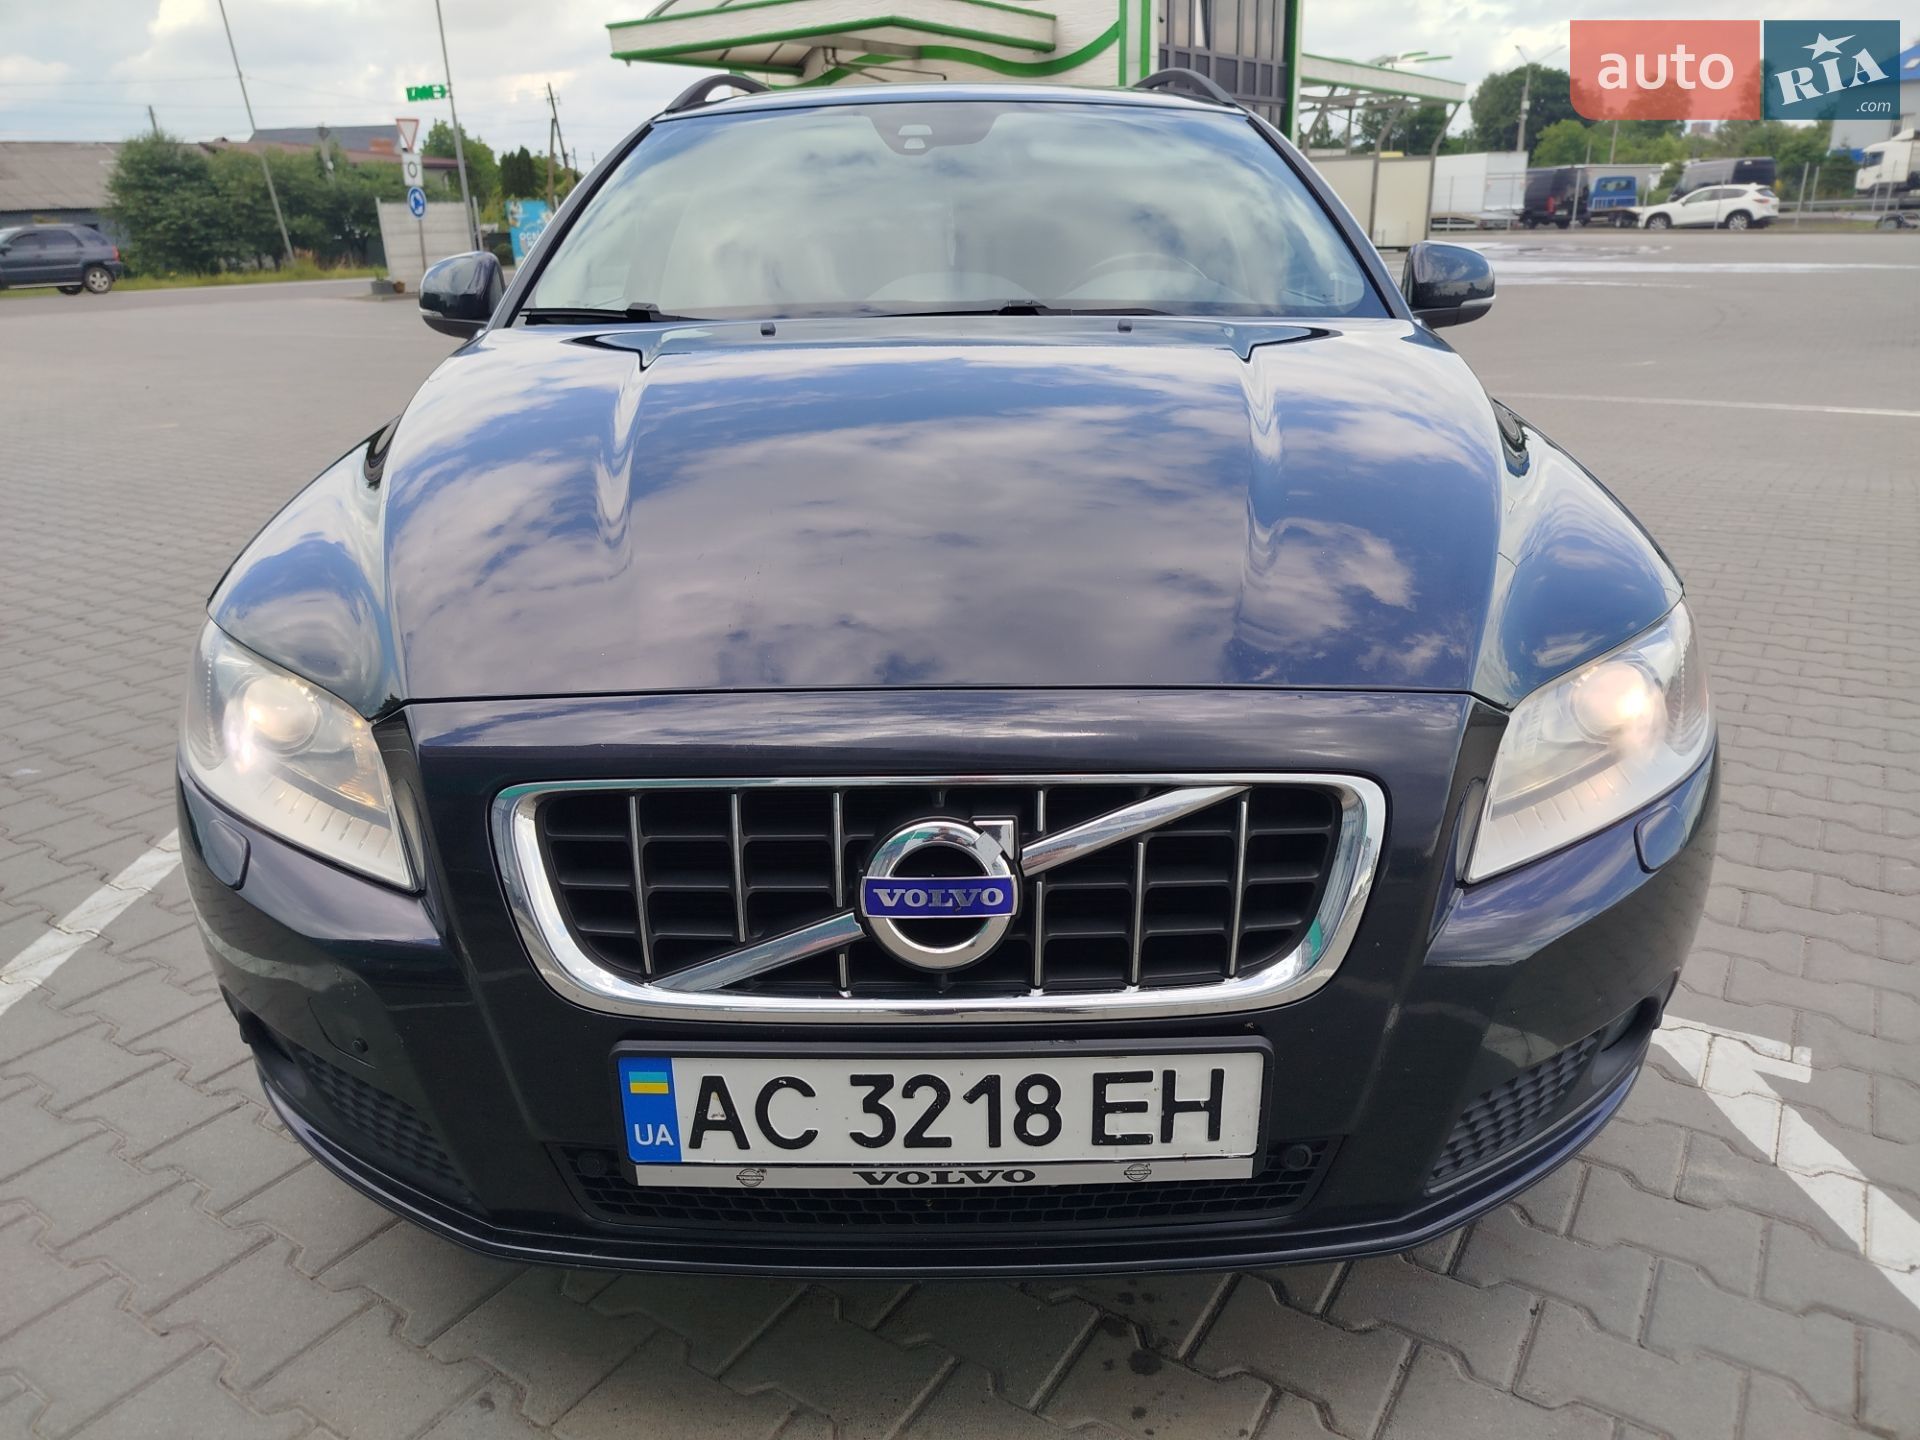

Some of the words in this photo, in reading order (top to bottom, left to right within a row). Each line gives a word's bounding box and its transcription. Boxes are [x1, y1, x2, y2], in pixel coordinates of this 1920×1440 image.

[873, 888, 1004, 907] VOLVO
[688, 1076, 818, 1150] AC
[849, 1074, 1063, 1148] 3218
[1091, 1068, 1225, 1146] EH
[634, 1123, 673, 1146] UA
[853, 1168, 1036, 1185] VOLVO
